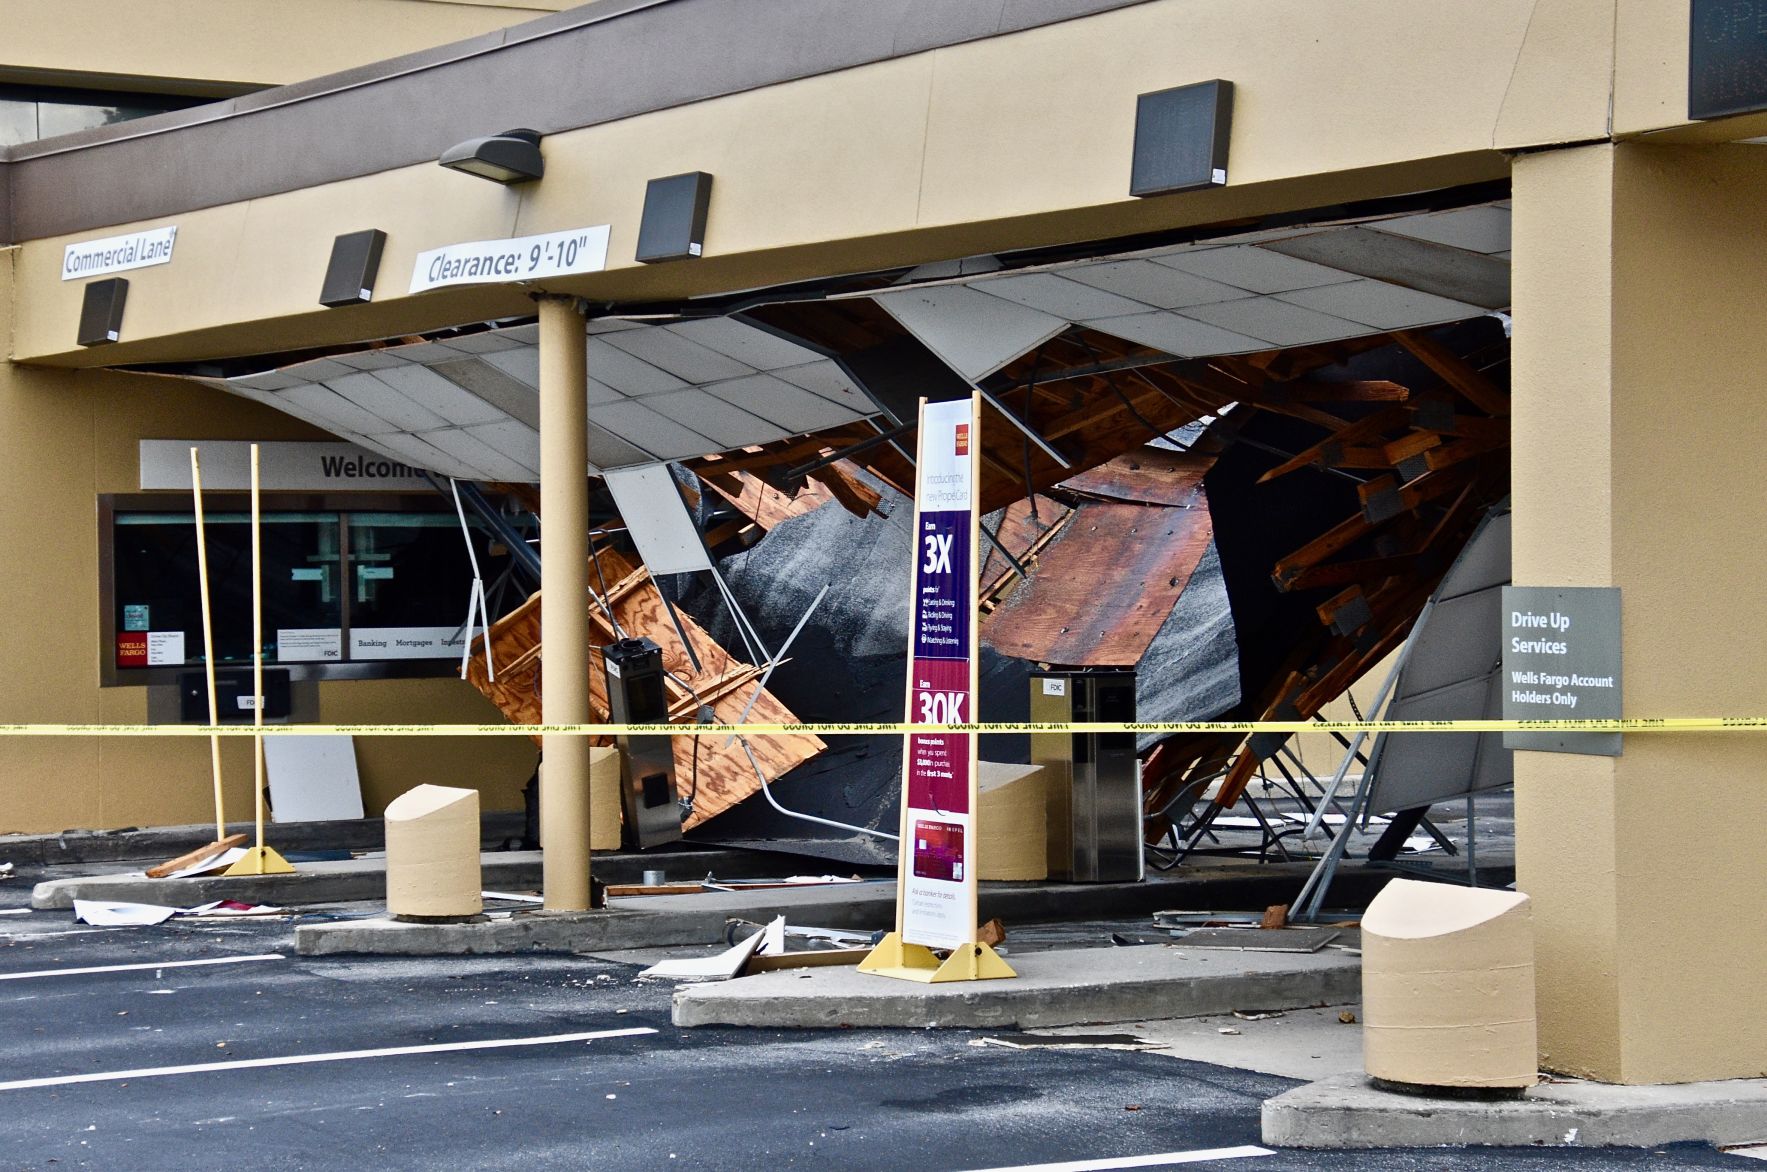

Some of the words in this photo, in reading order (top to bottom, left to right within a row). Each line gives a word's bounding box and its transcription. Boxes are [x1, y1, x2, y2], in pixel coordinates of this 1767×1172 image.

[65, 238, 140, 273] Commercial
[140, 238, 171, 260] Lane
[428, 253, 521, 283] Clearance:
[925, 521, 936, 530] Earn
[923, 534, 953, 574] 3X
[1511, 611, 1548, 628] Drive
[1550, 612, 1570, 632] Up
[358, 639, 387, 648] Banking
[395, 639, 433, 647] Mortgages
[1511, 637, 1567, 654] Services
[1511, 671, 1539, 685] Wells
[1540, 673, 1569, 688] Fargo
[1571, 674, 1614, 688] Account
[918, 691, 965, 724] 30K
[1511, 690, 1551, 705] Holders
[1552, 692, 1578, 708] Only
